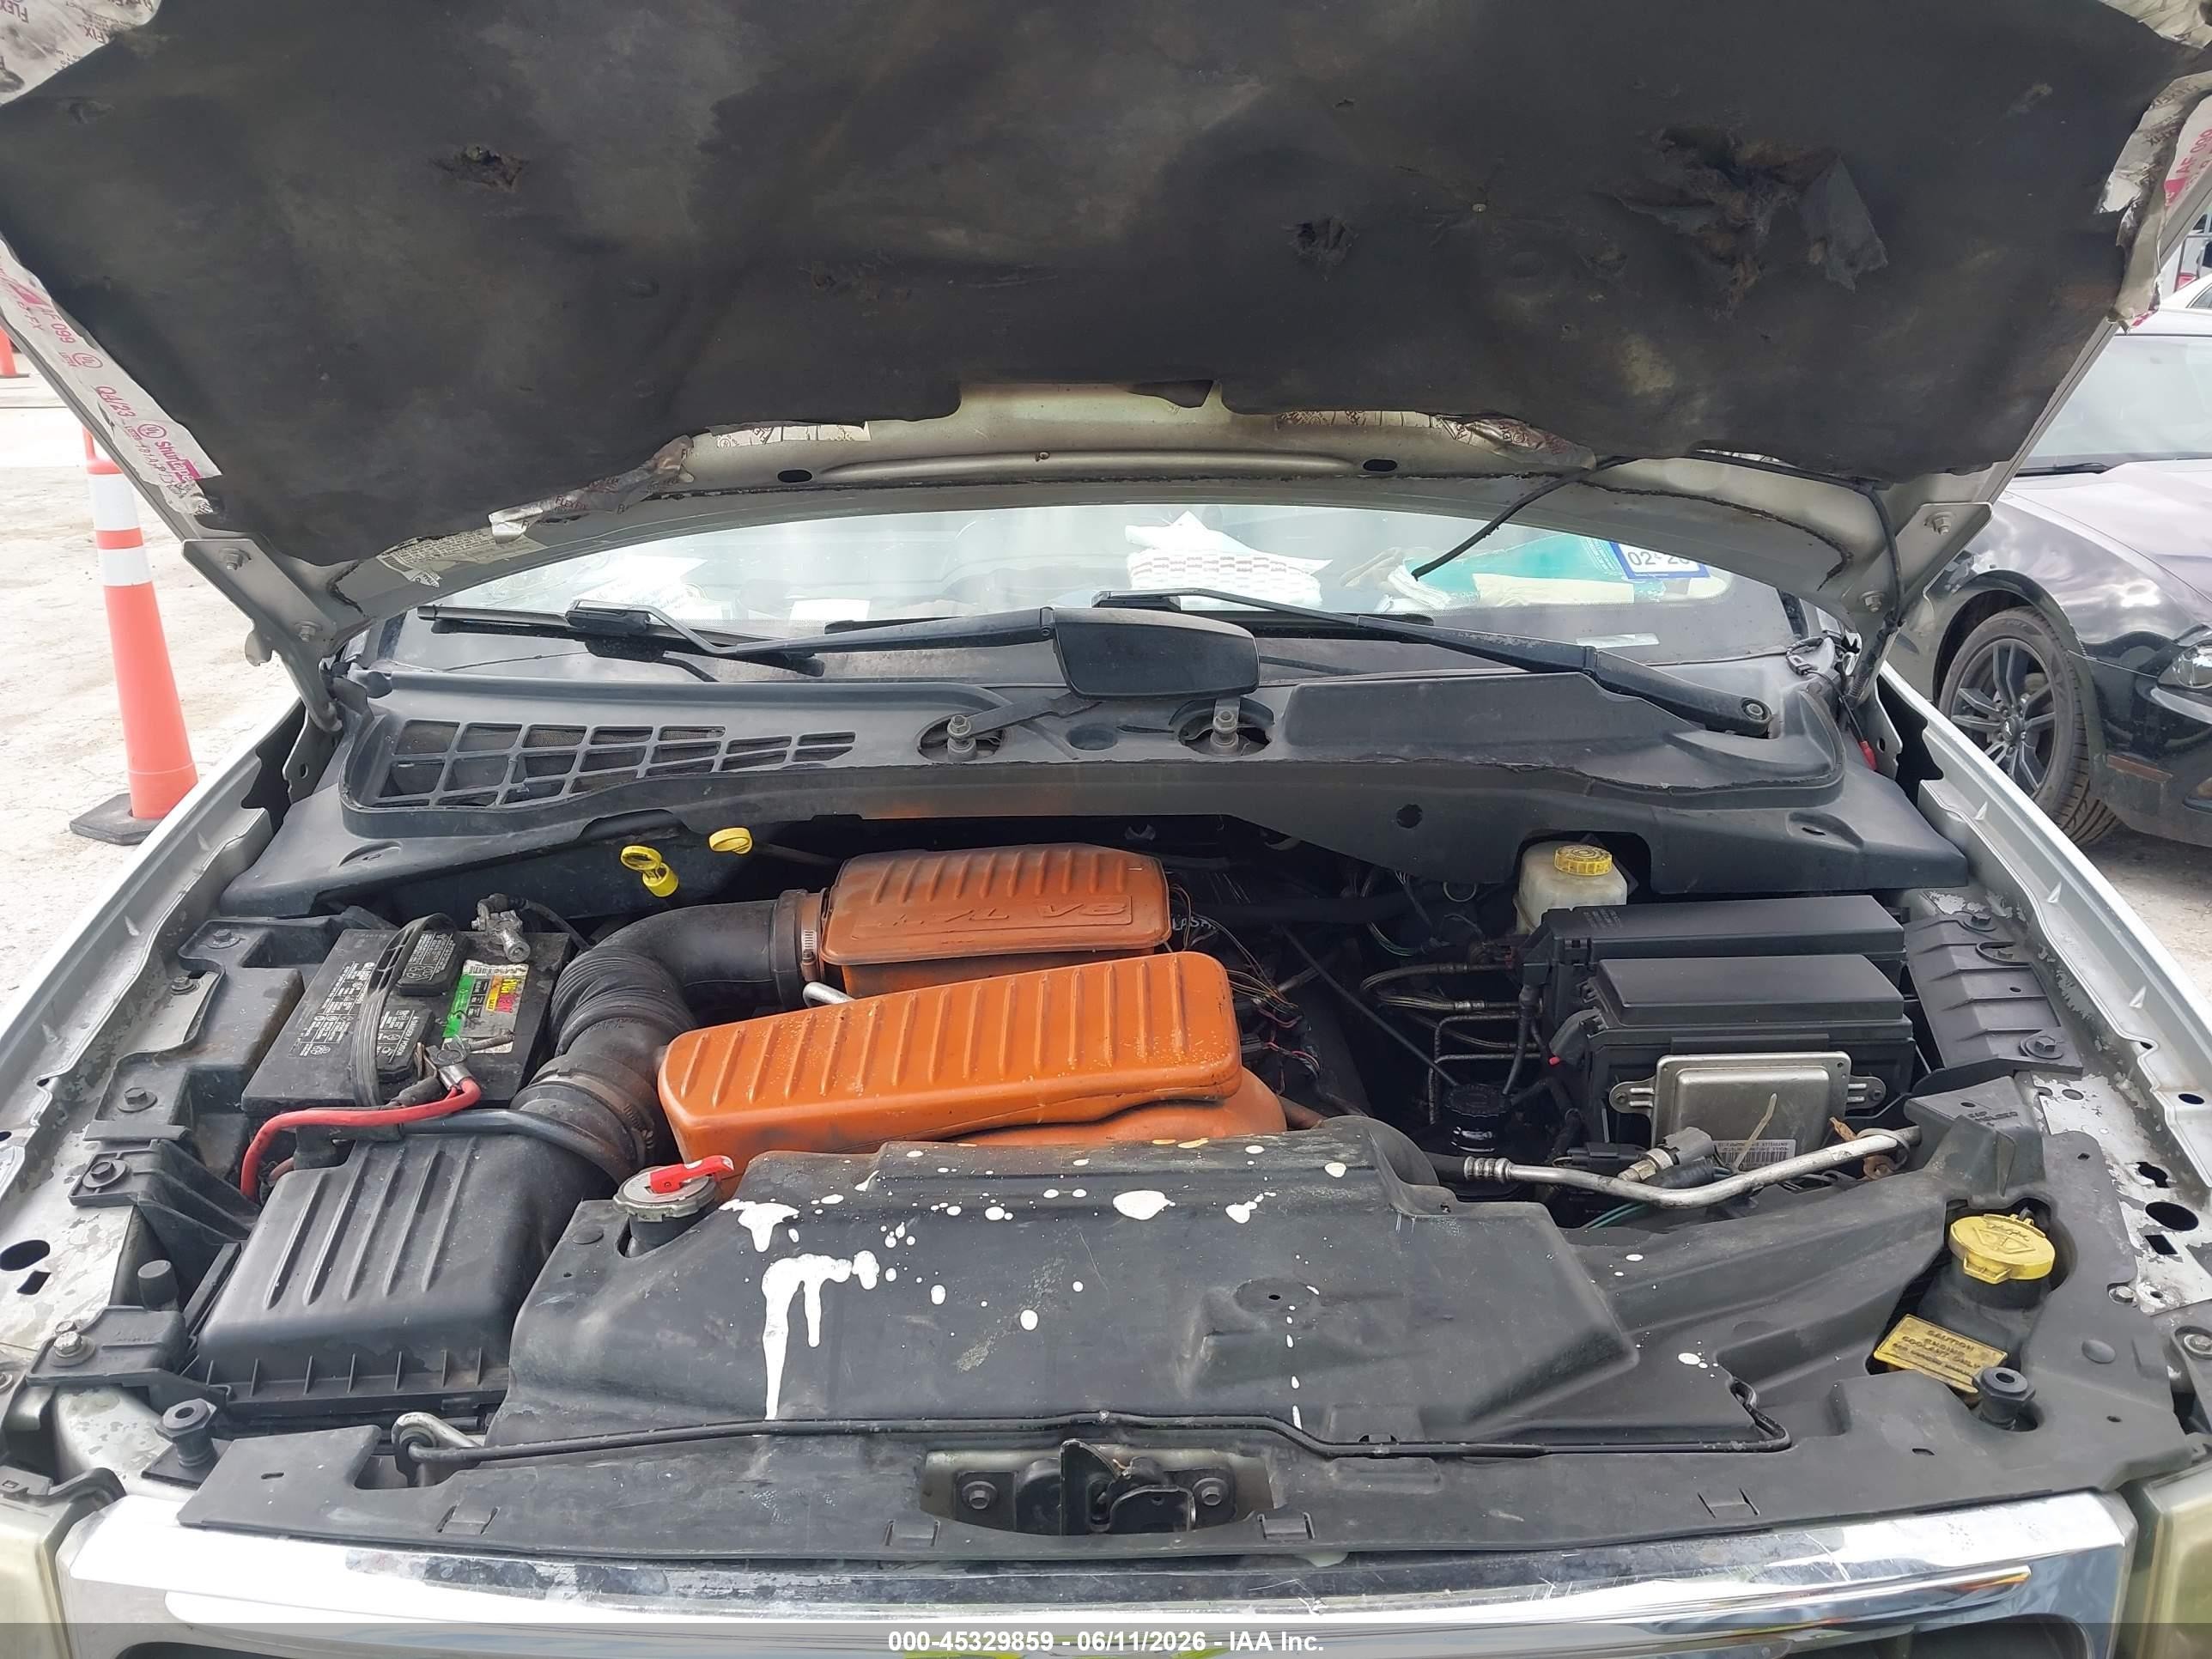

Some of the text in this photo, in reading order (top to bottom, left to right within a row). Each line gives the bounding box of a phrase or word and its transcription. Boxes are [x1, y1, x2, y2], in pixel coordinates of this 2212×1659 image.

[52, 323, 76, 343] 099
[95, 386, 136, 418] Q4/23
[155, 441, 194, 484] Shurtape
